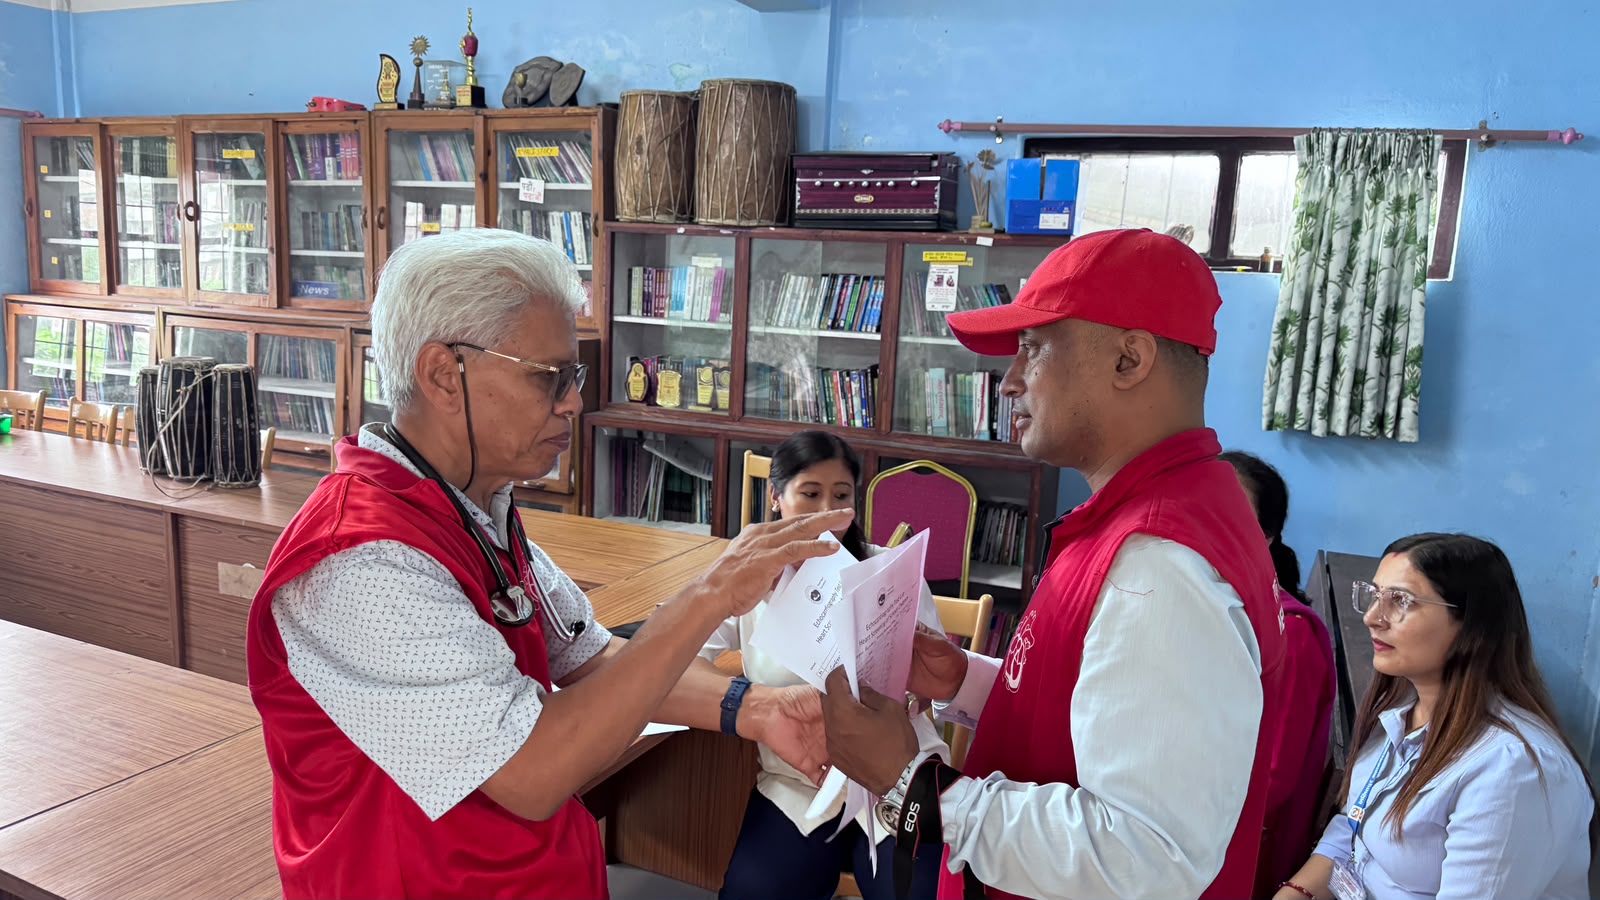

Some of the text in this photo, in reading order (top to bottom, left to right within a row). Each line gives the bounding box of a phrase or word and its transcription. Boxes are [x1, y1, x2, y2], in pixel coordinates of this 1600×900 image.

[300, 284, 330, 296] News
[816, 627, 826, 645] Heart
[904, 801, 921, 833] EOS
